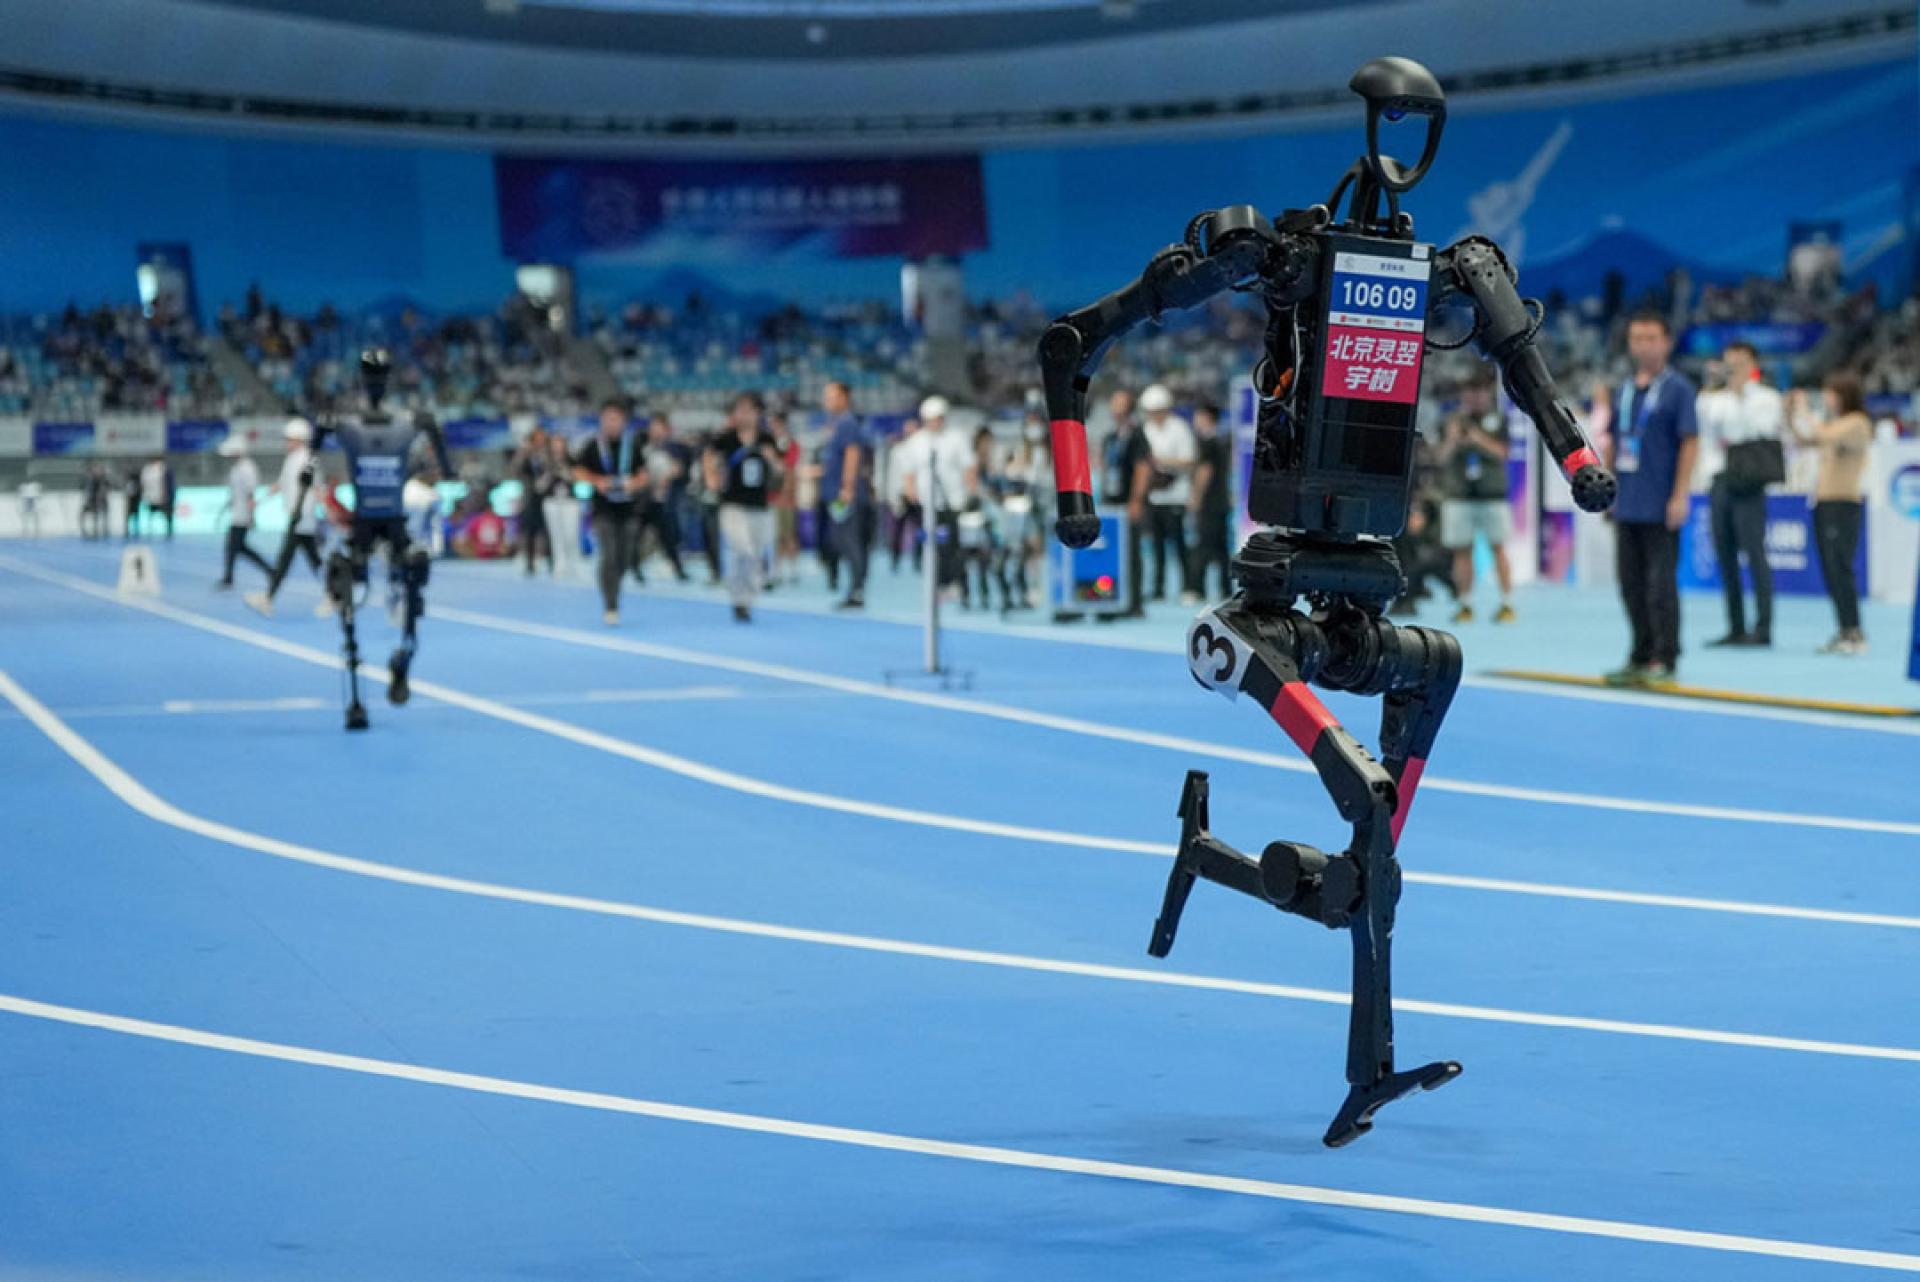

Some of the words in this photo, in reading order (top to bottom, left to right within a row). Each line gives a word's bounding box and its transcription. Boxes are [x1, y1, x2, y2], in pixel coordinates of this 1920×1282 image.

[1329, 334, 1419, 366] 北京灵翌
[1343, 365, 1399, 394] 宇树
[1192, 623, 1236, 682] 3
